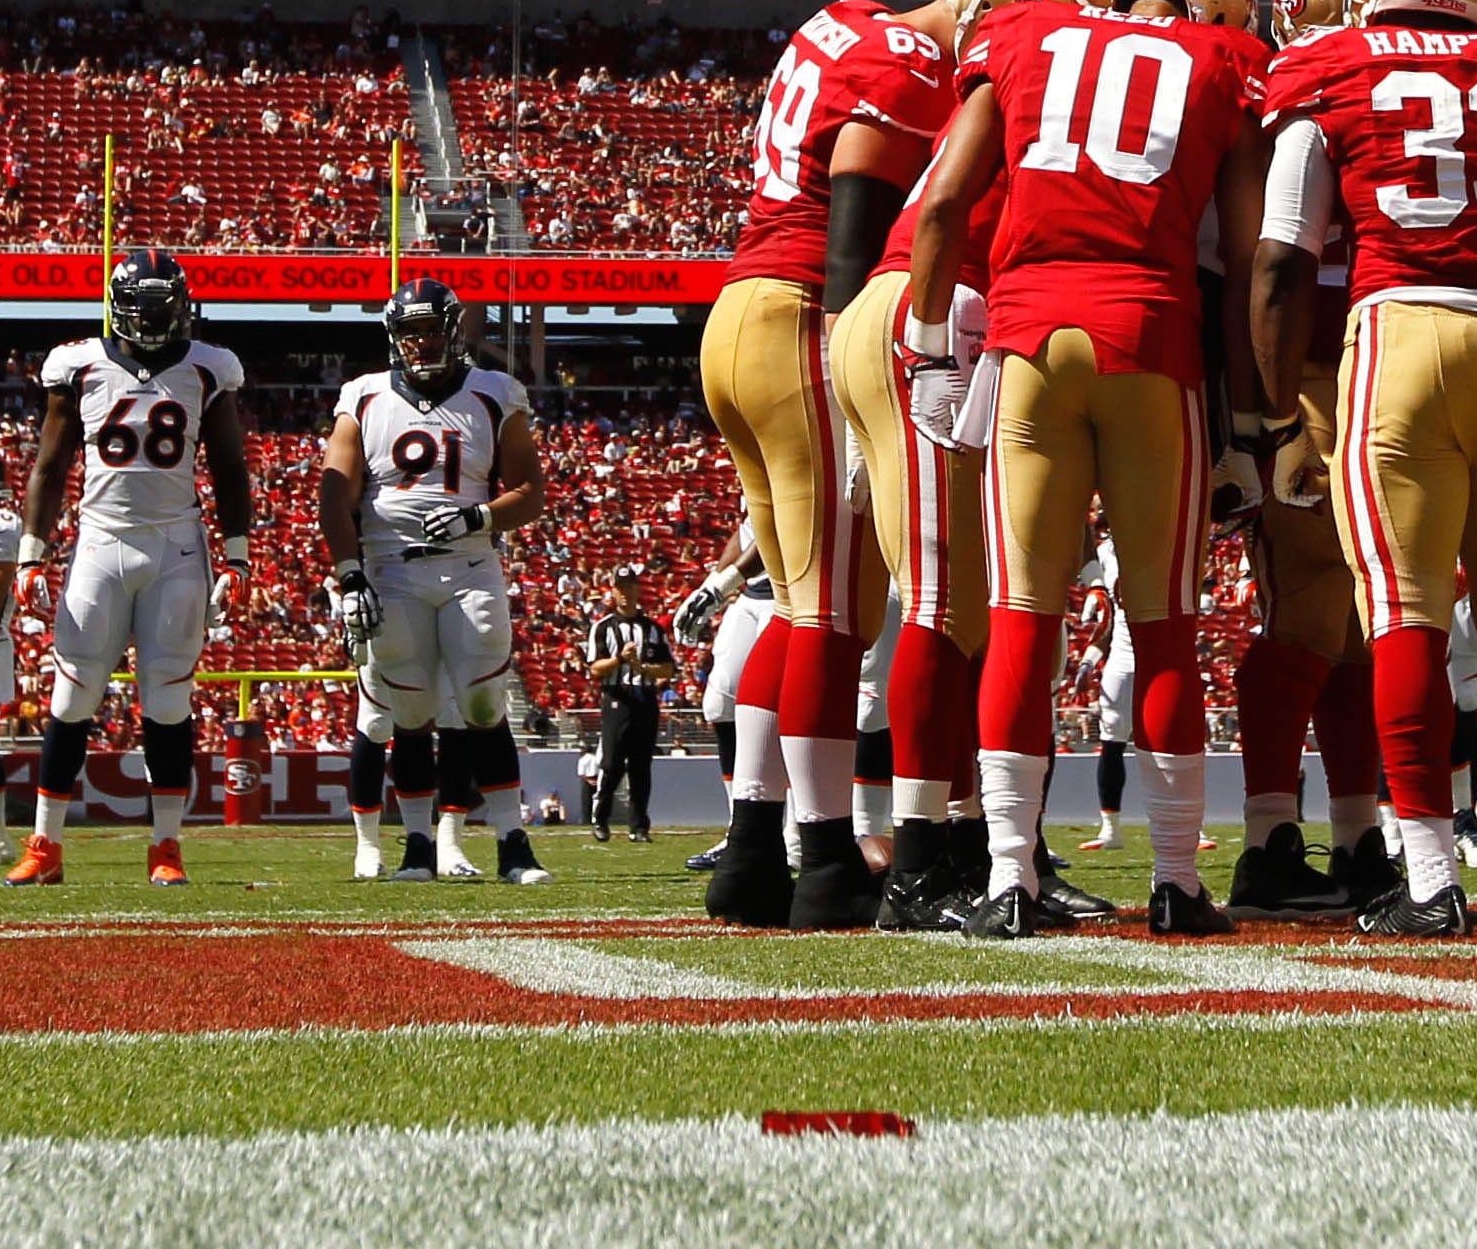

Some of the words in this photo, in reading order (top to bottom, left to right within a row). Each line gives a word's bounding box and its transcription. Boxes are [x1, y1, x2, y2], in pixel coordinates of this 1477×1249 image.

[884, 26, 941, 61] 69
[1020, 26, 1194, 184] 10
[11, 264, 74, 291] OLD,
[187, 265, 270, 291] OGGY,
[280, 266, 377, 291] SOGGY
[493, 268, 550, 295] QUO
[561, 269, 687, 294] STADIUM.
[96, 398, 188, 469] 68
[392, 429, 462, 494] 91
